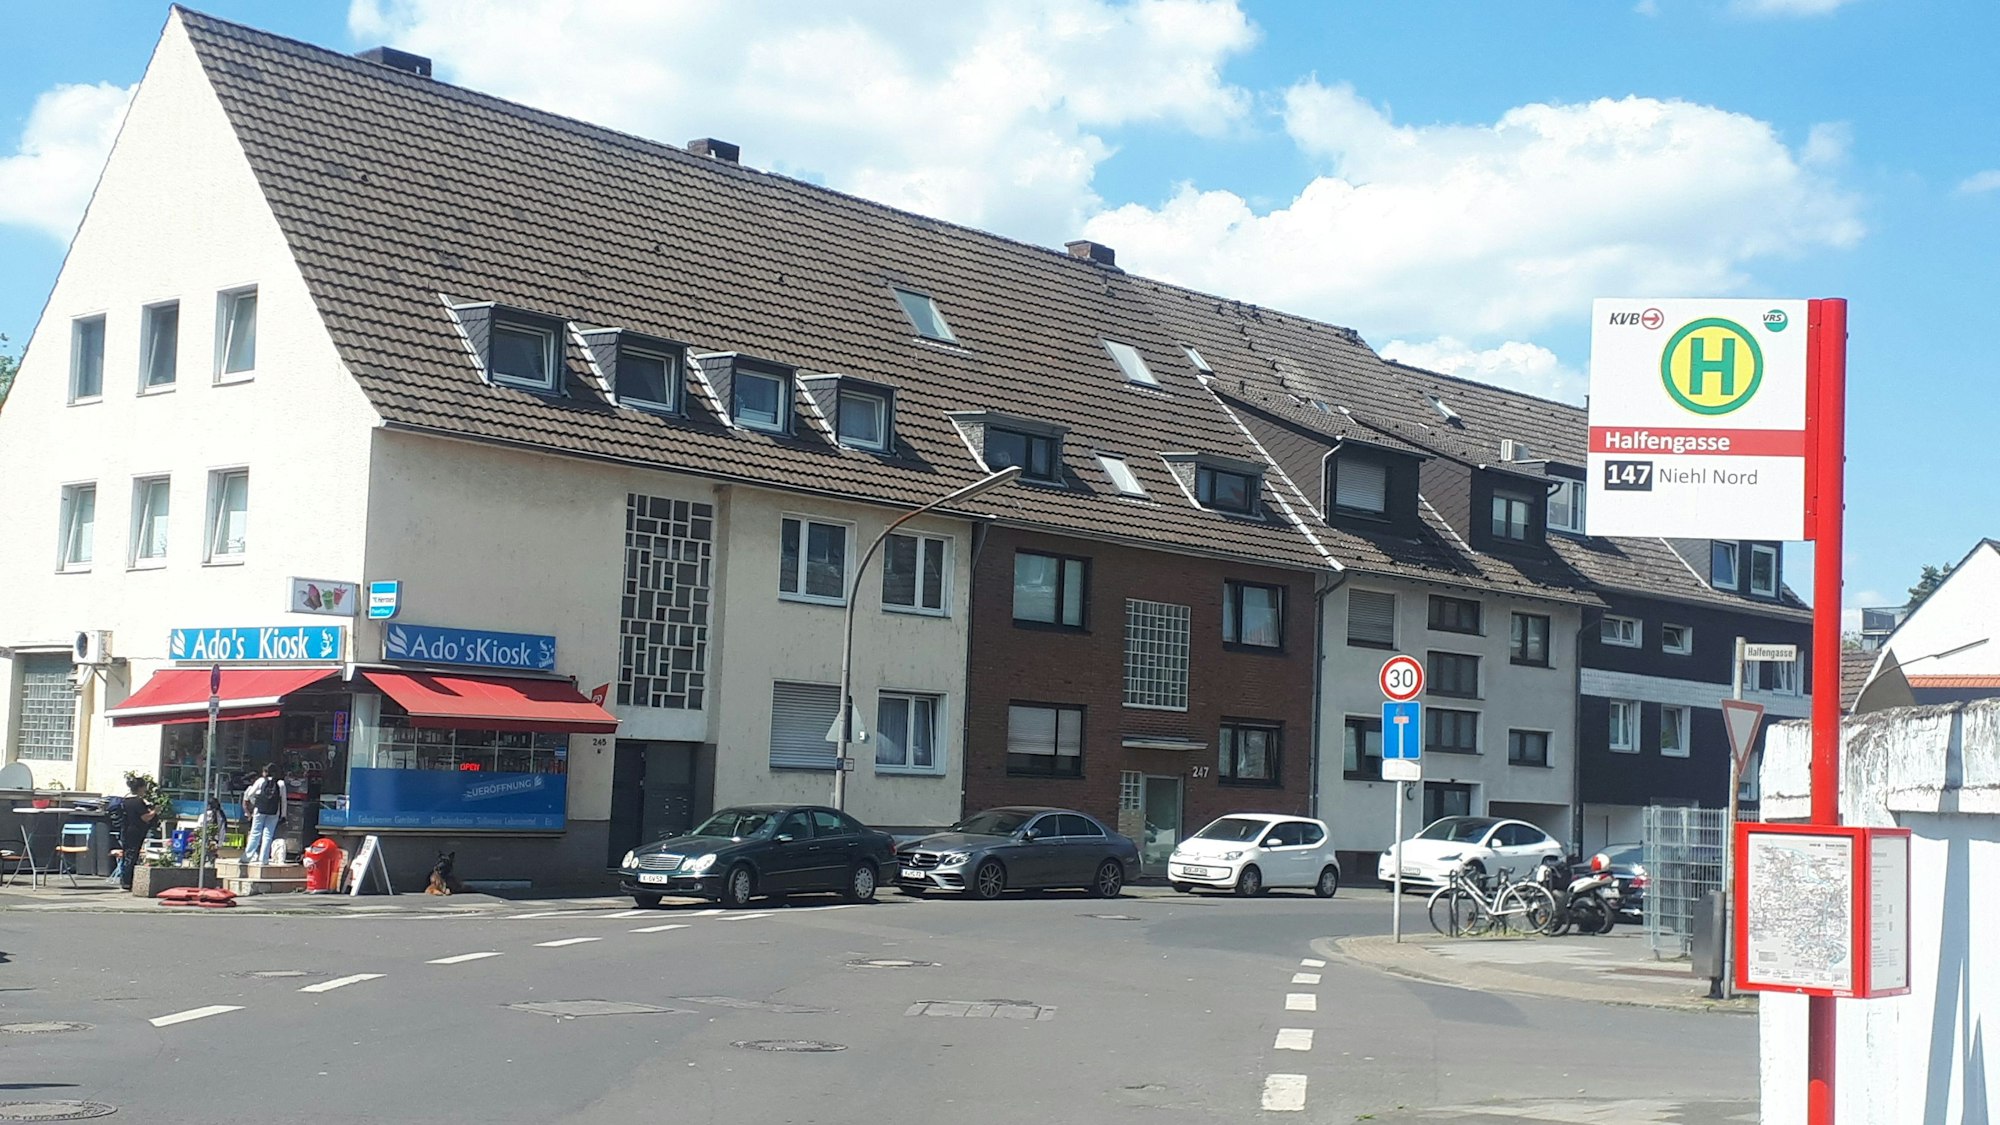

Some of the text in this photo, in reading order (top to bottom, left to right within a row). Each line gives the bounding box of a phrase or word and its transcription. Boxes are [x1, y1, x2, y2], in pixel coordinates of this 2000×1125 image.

[1609, 312, 1640, 325] KVB
[1762, 313, 1783, 322] VRS
[1689, 337, 1735, 395] H
[1605, 431, 1730, 453] Halfengasse
[1607, 464, 1758, 485] 147 Niehl Nord
[192, 627, 309, 659] Ado's Kiosk
[1747, 647, 1793, 659] Halfengasse
[1389, 669, 1413, 688] 30
[592, 738, 607, 747] 245
[459, 762, 480, 771] OPEN
[1192, 766, 1209, 778] 247
